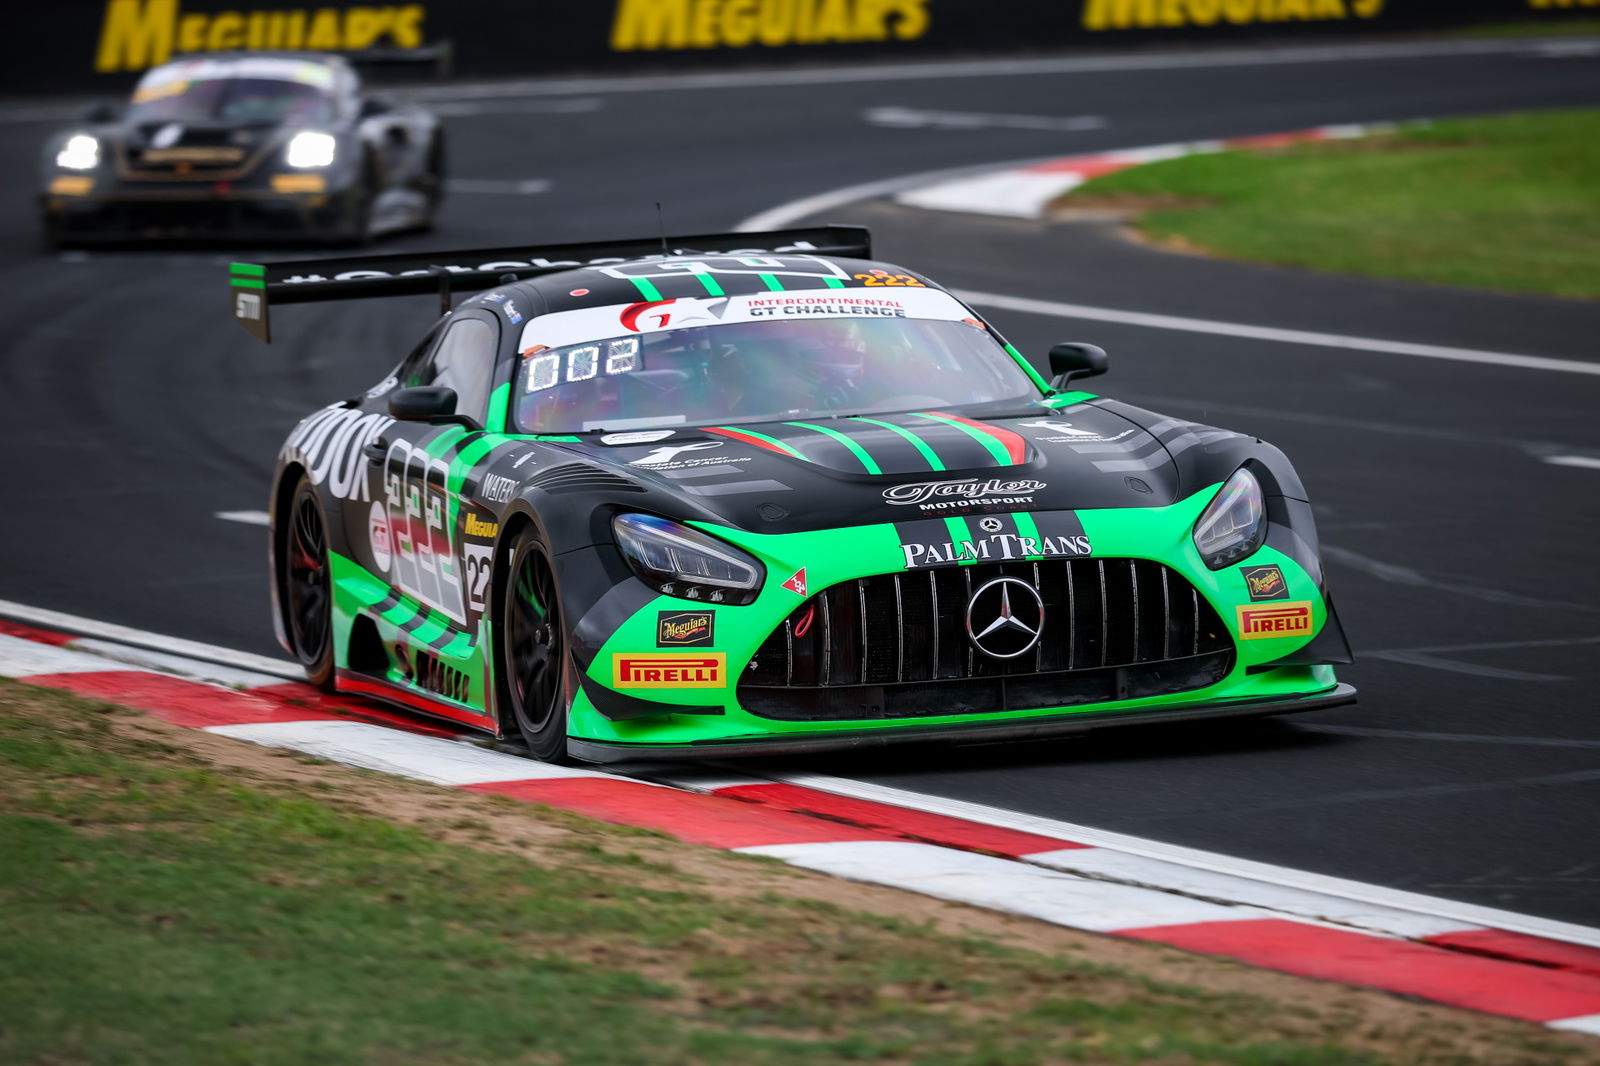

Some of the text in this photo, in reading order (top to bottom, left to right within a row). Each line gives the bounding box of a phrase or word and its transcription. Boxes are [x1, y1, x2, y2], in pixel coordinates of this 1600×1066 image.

[611, 0, 929, 49] MEGUIARS
[854, 274, 926, 287] 222
[748, 297, 904, 308] INTERCONTINENTAL
[750, 305, 906, 318] GT CHALLENGE
[527, 338, 638, 393] 002
[882, 477, 1047, 505] Taylor
[919, 496, 1034, 511] MOTORSPORT
[662, 616, 708, 639] Meguiar's
[1242, 607, 1308, 633] PIRELLI
[620, 659, 719, 682] PIRELLI
